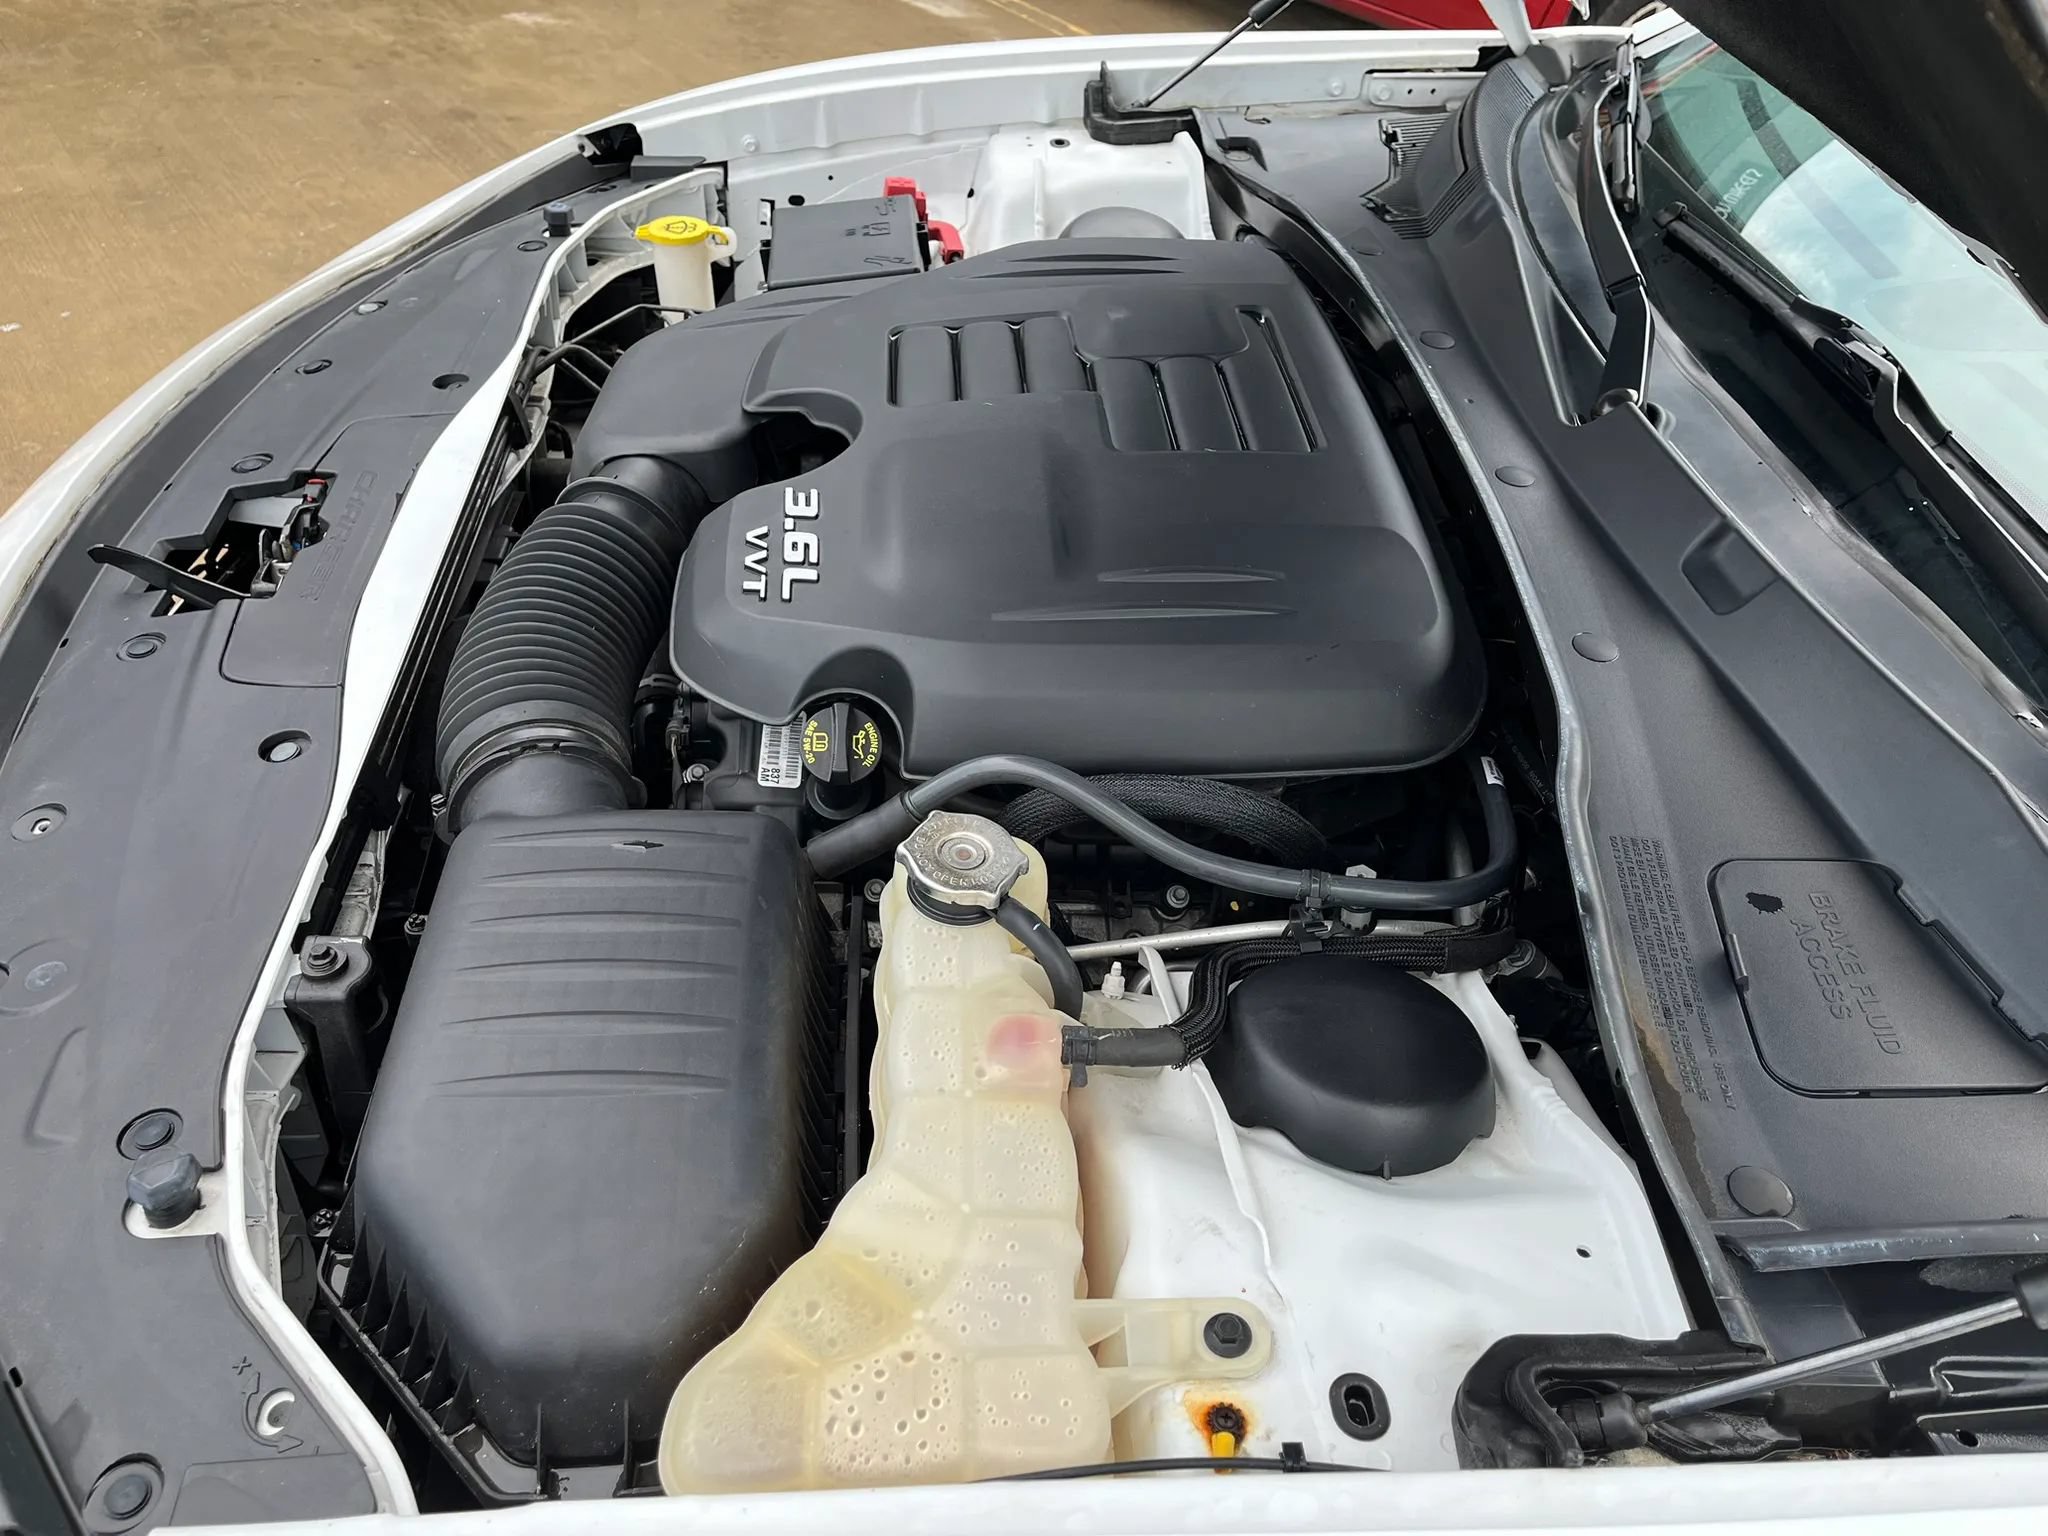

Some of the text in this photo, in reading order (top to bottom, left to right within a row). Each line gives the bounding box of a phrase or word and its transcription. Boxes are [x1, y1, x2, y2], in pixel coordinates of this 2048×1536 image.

[782, 487, 819, 603] 3.6L
[743, 525, 769, 603] VVT
[802, 719, 819, 764] SAE 5W-20
[862, 721, 879, 768] ENGINE OIL
[760, 767, 770, 783] AM
[770, 768, 781, 785] 837
[1641, 838, 1653, 856] DOT
[1648, 863, 1660, 888] FLUID
[1654, 889, 1668, 915] FROM
[1664, 924, 1679, 960] SEALED
[1663, 883, 1679, 911] CLEAN
[1671, 913, 1686, 943] FILLER
[1680, 945, 1692, 964] CAP
[1789, 919, 1853, 1021] ACCESS
[1685, 966, 1703, 1003] BEFORE
[1808, 892, 1903, 1055] BRAKE FLUID
[1713, 1063, 1727, 1082] USE
[1720, 1083, 1736, 1111] ONLY
